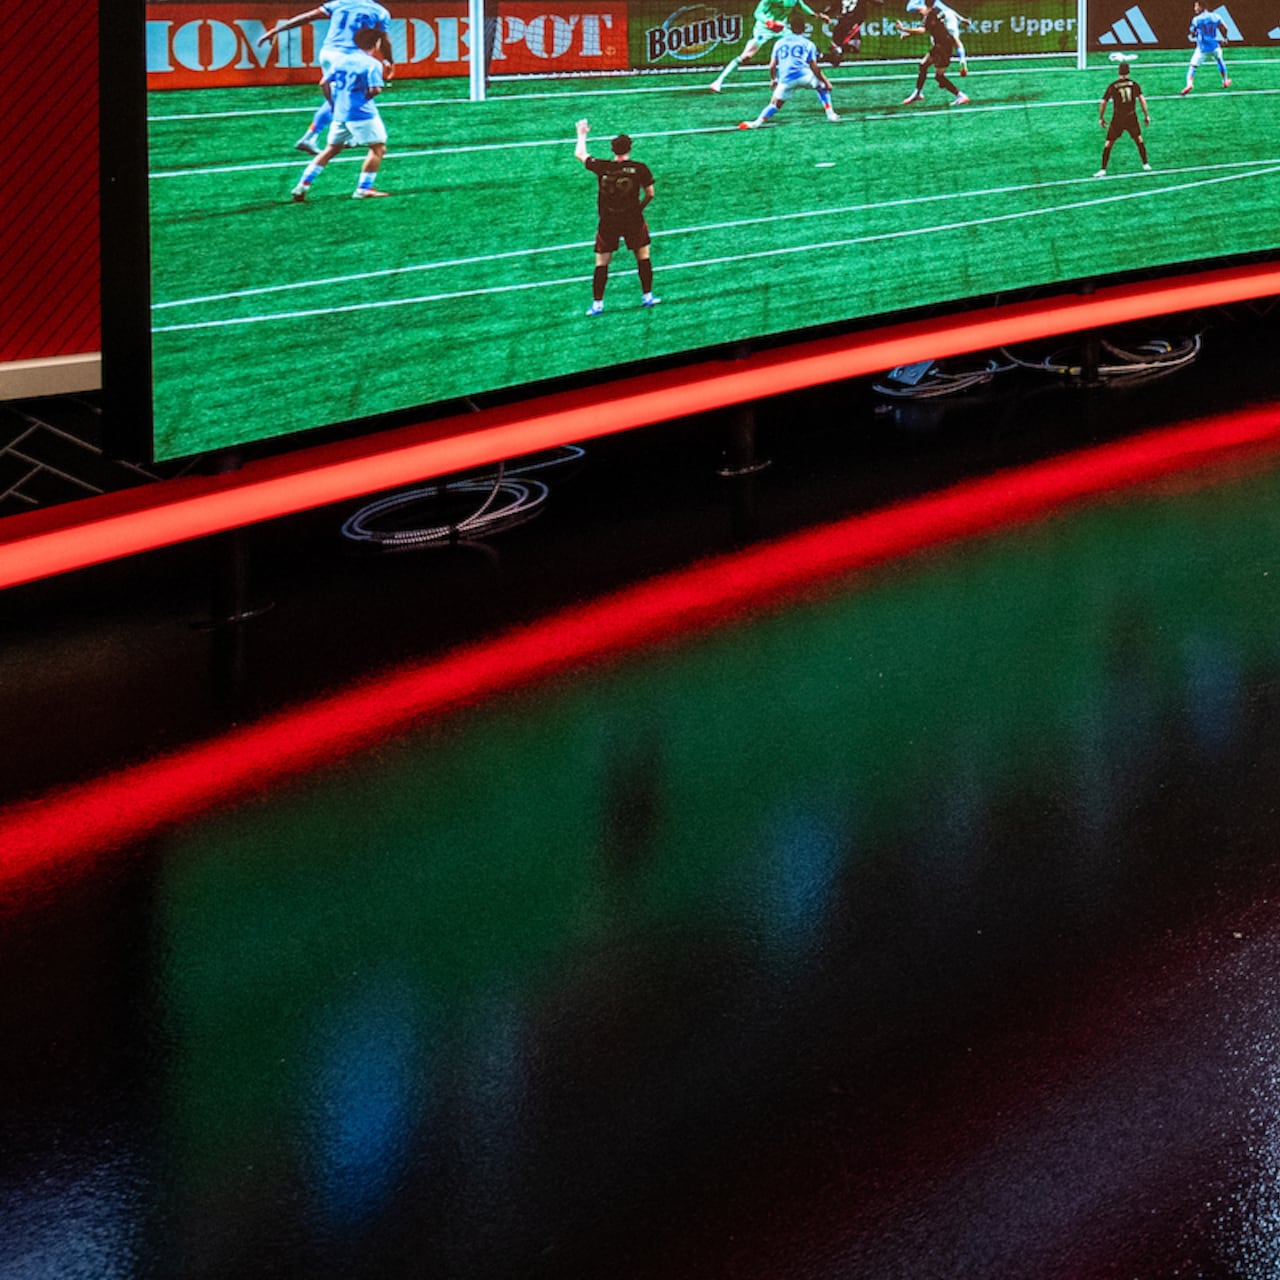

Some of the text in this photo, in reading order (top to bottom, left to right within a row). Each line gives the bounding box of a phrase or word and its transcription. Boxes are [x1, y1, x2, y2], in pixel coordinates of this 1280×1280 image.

[646, 13, 744, 63] Bounty
[1009, 15, 1076, 37] Upper
[147, 19, 330, 72] OM
[333, 69, 359, 92] 32
